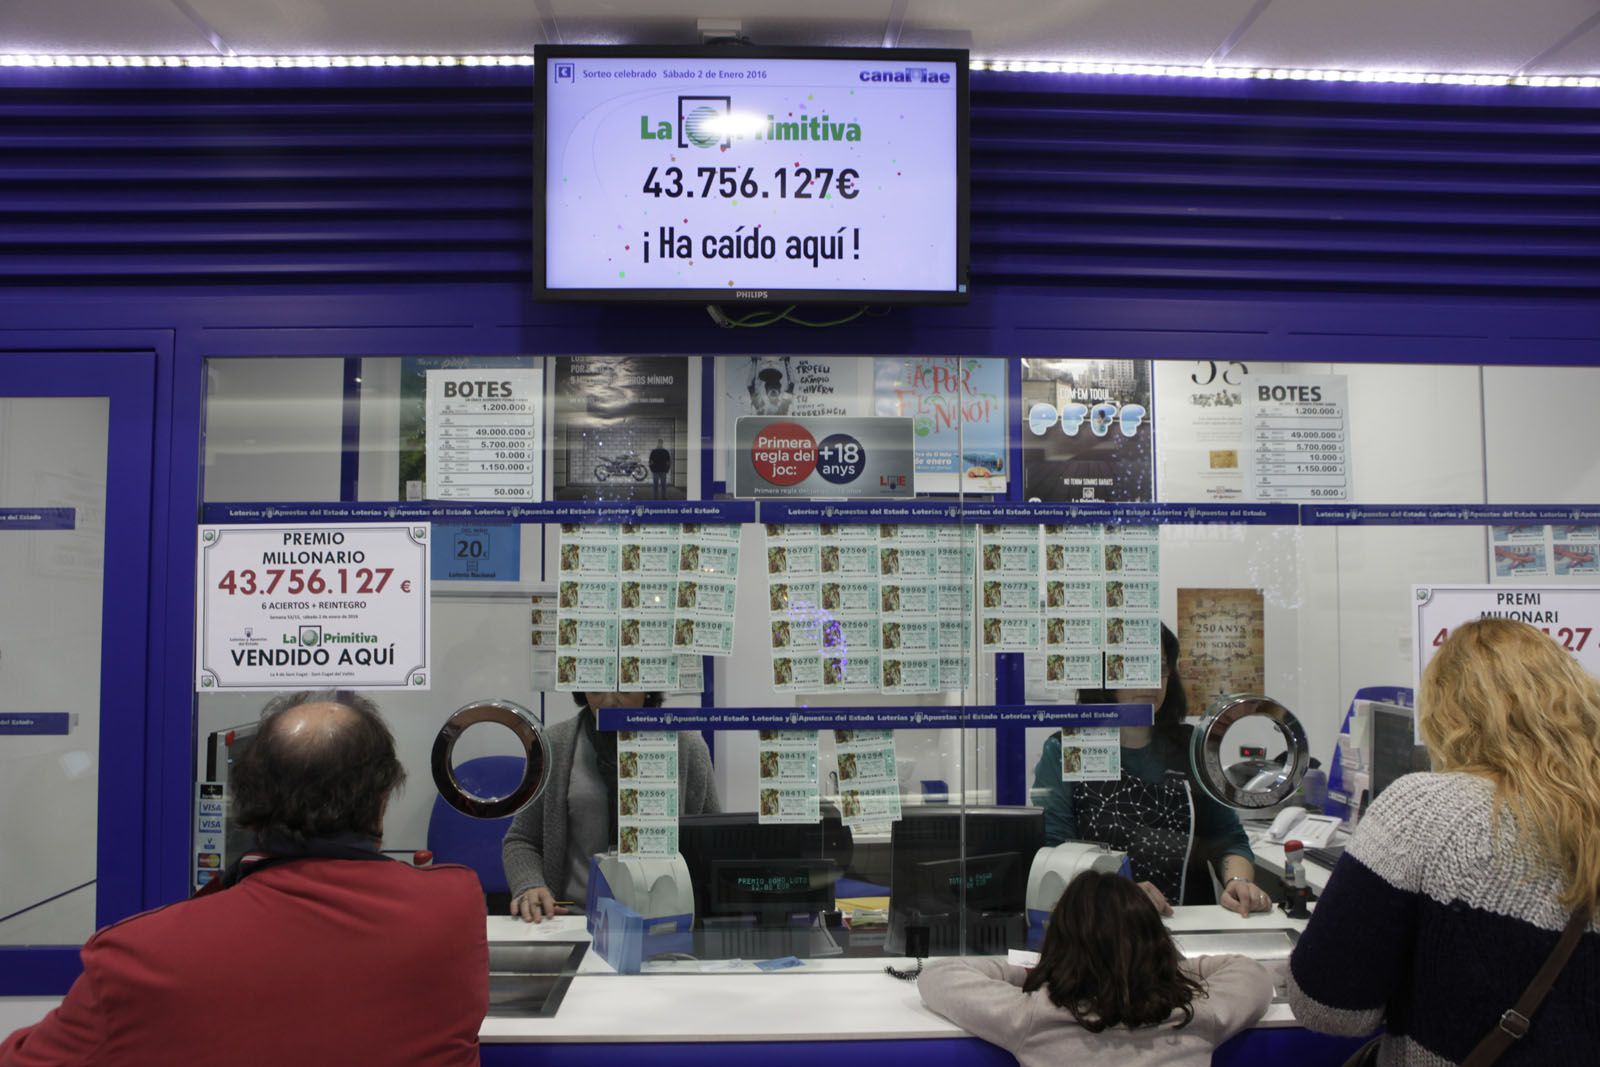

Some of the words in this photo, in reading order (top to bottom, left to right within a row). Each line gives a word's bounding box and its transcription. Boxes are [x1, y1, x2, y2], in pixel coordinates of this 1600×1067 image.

[583, 69, 612, 79] Sorteo
[614, 69, 657, 79] celebrado
[662, 68, 696, 79] Sábado
[698, 70, 703, 79] 2
[705, 69, 716, 79] de
[719, 70, 744, 80] Enero
[746, 69, 768, 79] 2016
[641, 115, 673, 140] La
[642, 166, 860, 200] 43.756.127€
[702, 225, 776, 260] caído
[736, 290, 768, 299] PHILIPS
[647, 373, 674, 385] MÍNIMO
[444, 381, 513, 398] BOTES
[1258, 385, 1322, 402] BOTES
[482, 403, 526, 411] 1.200.000
[1295, 407, 1335, 415] 1.200.000
[476, 428, 526, 436] 49.000.000
[1291, 431, 1336, 439] 49.000.000
[481, 441, 525, 449] 5.700.000
[758, 436, 812, 449] Primera
[1296, 443, 1337, 451] 5.700.000
[755, 449, 789, 464] regla
[793, 449, 815, 461] del
[819, 443, 860, 464] +18
[480, 463, 524, 471] 1.150.000
[772, 463, 797, 478] joc:
[822, 464, 856, 477] anys
[1297, 465, 1337, 473] 1.150.000
[494, 488, 524, 496] 50.000
[283, 531, 345, 546] PREMIO
[457, 540, 482, 558] 20
[262, 550, 365, 565] MILLONARIO
[218, 567, 395, 596] 43.756.127
[400, 580, 411, 593] €
[261, 602, 267, 610] 6
[268, 602, 309, 610] ACIERTOS
[318, 601, 366, 609] REINTEGRO
[1497, 593, 1541, 606] PREMI
[1195, 624, 1216, 633] 250
[1217, 624, 1247, 633] ANYS
[283, 633, 297, 644] La
[323, 632, 378, 644] Primitiva
[1196, 641, 1207, 649] DE
[1211, 641, 1247, 649] SOMNIS
[231, 648, 330, 667] VENDIDO
[338, 643, 395, 667] AQUÍ
[203, 803, 221, 811] VISA
[202, 820, 221, 828] VISA
